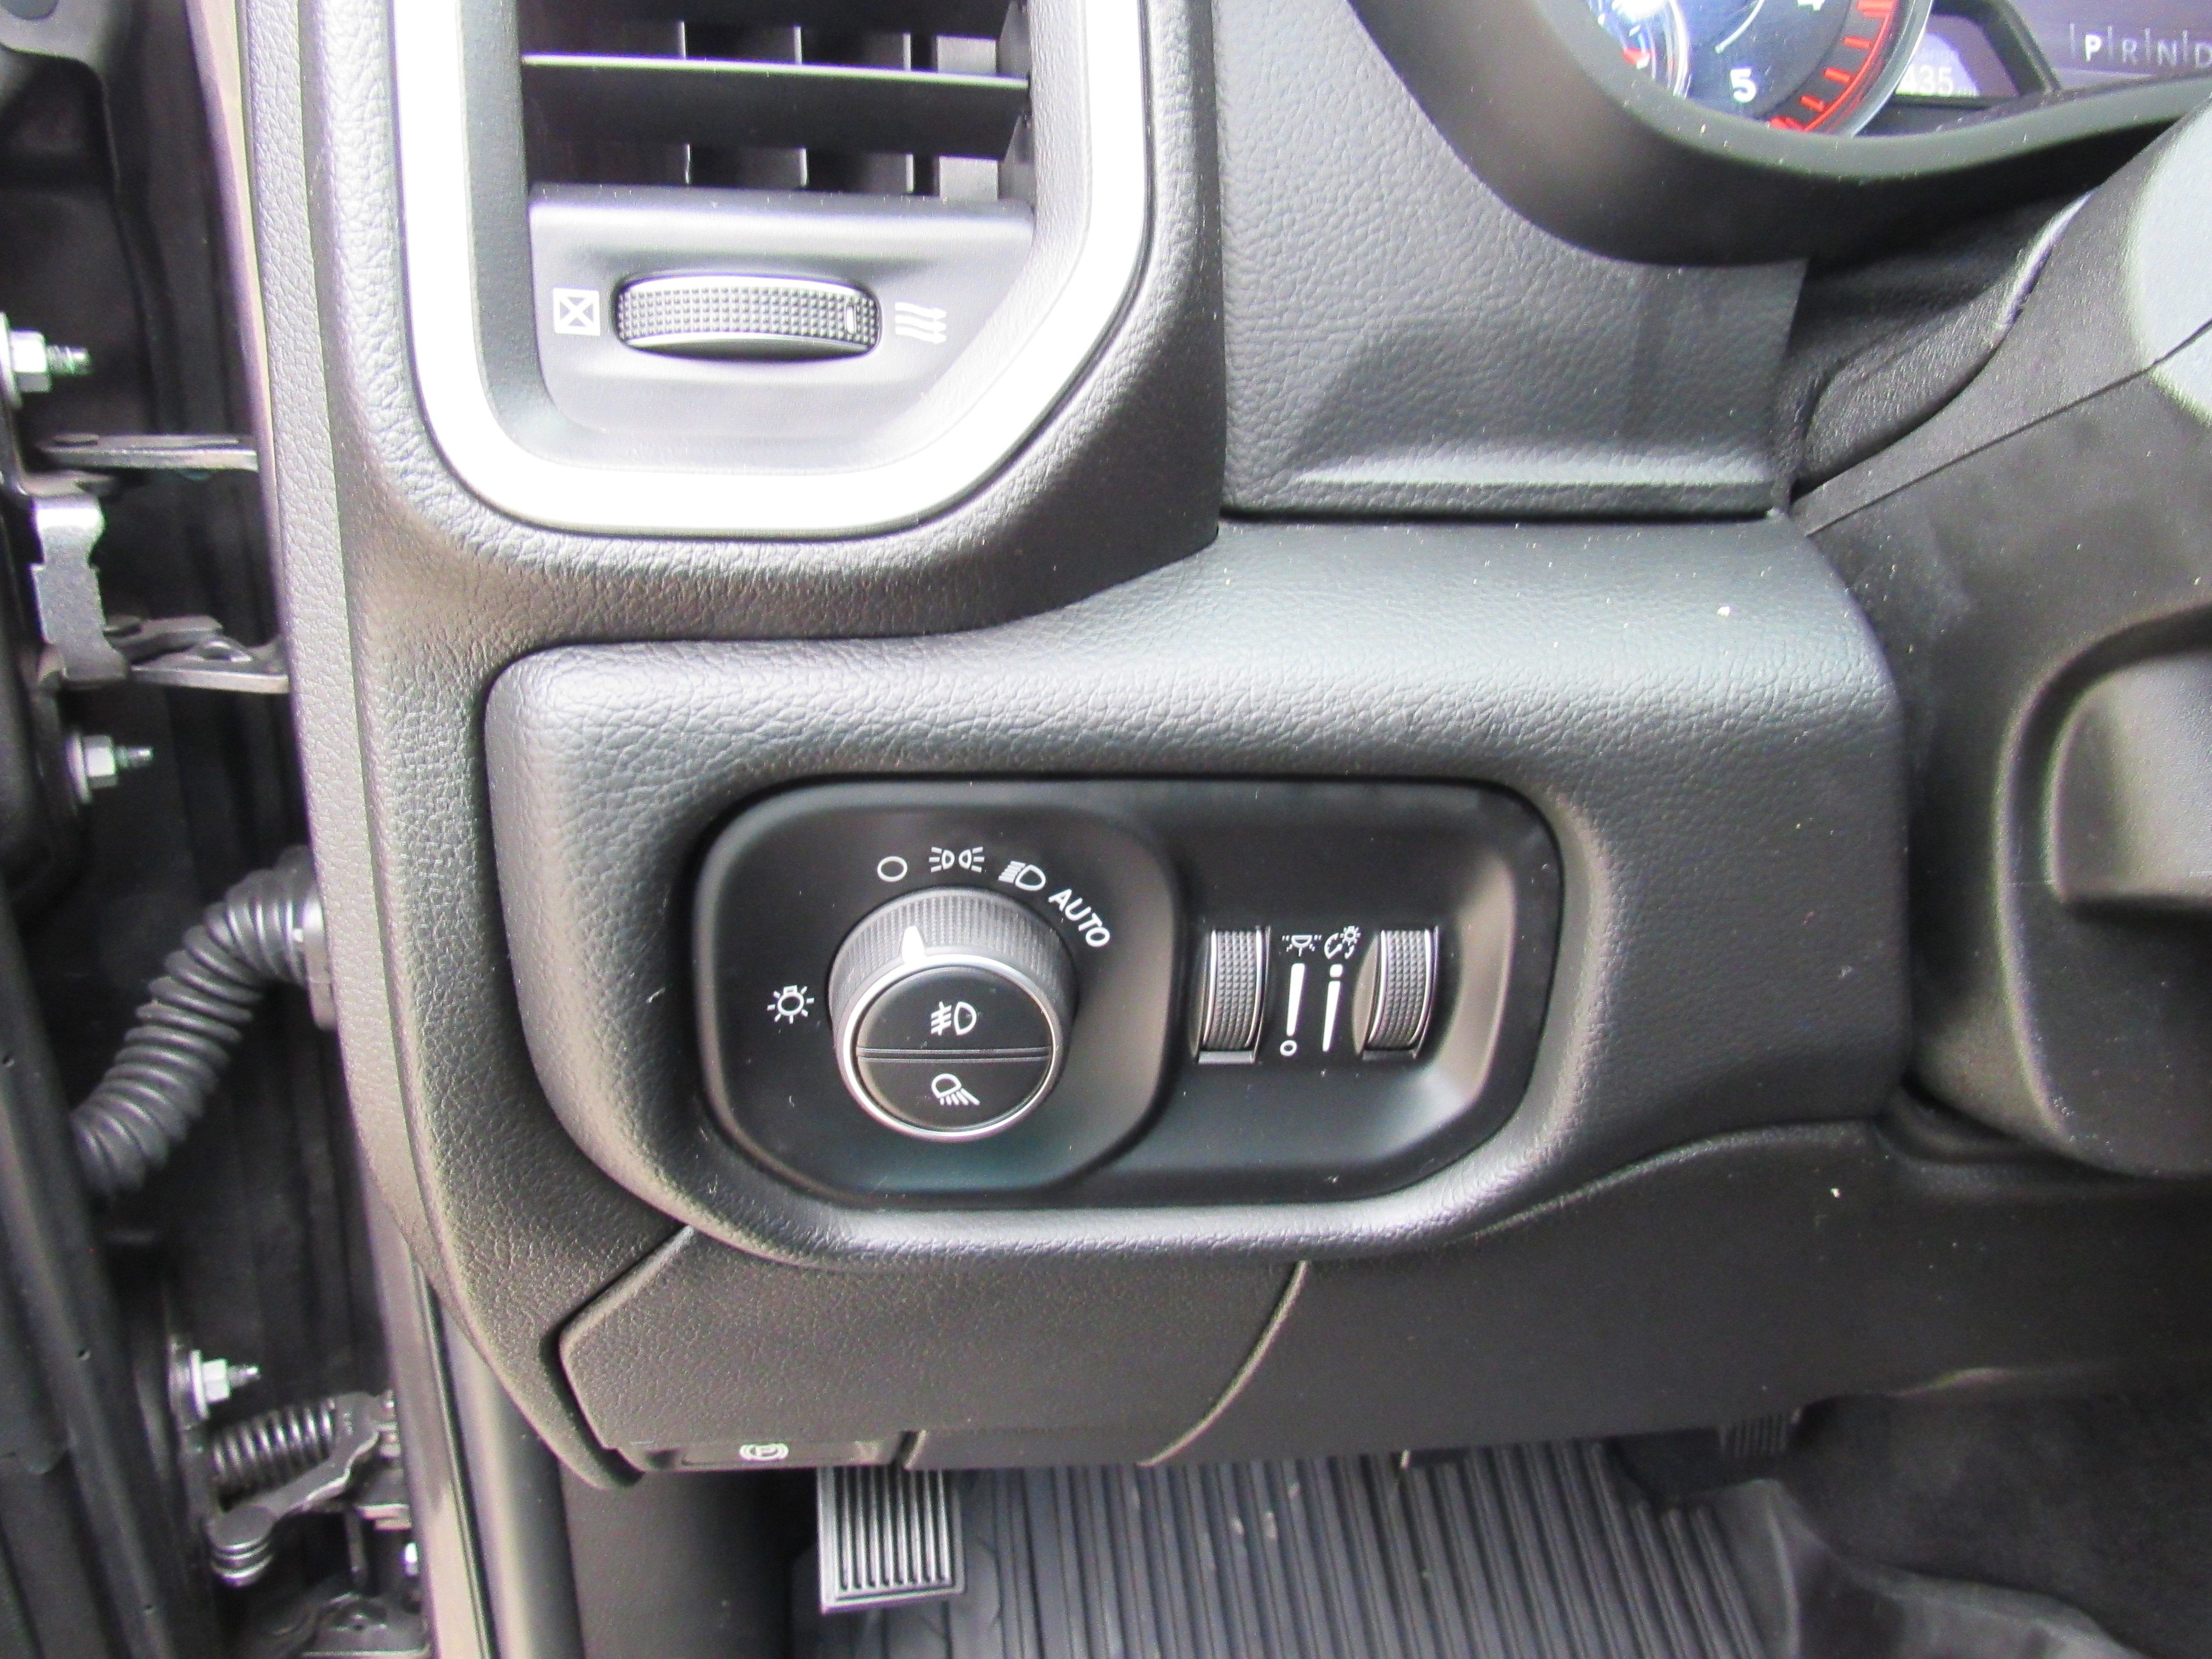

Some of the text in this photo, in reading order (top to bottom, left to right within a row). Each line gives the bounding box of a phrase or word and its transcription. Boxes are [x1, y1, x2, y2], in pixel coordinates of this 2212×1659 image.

[2084, 34, 2102, 61] P
[2122, 37, 2137, 65] R
[2157, 39, 2178, 66] N
[1730, 68, 1757, 103] 5
[1048, 888, 1110, 948] AUTO
